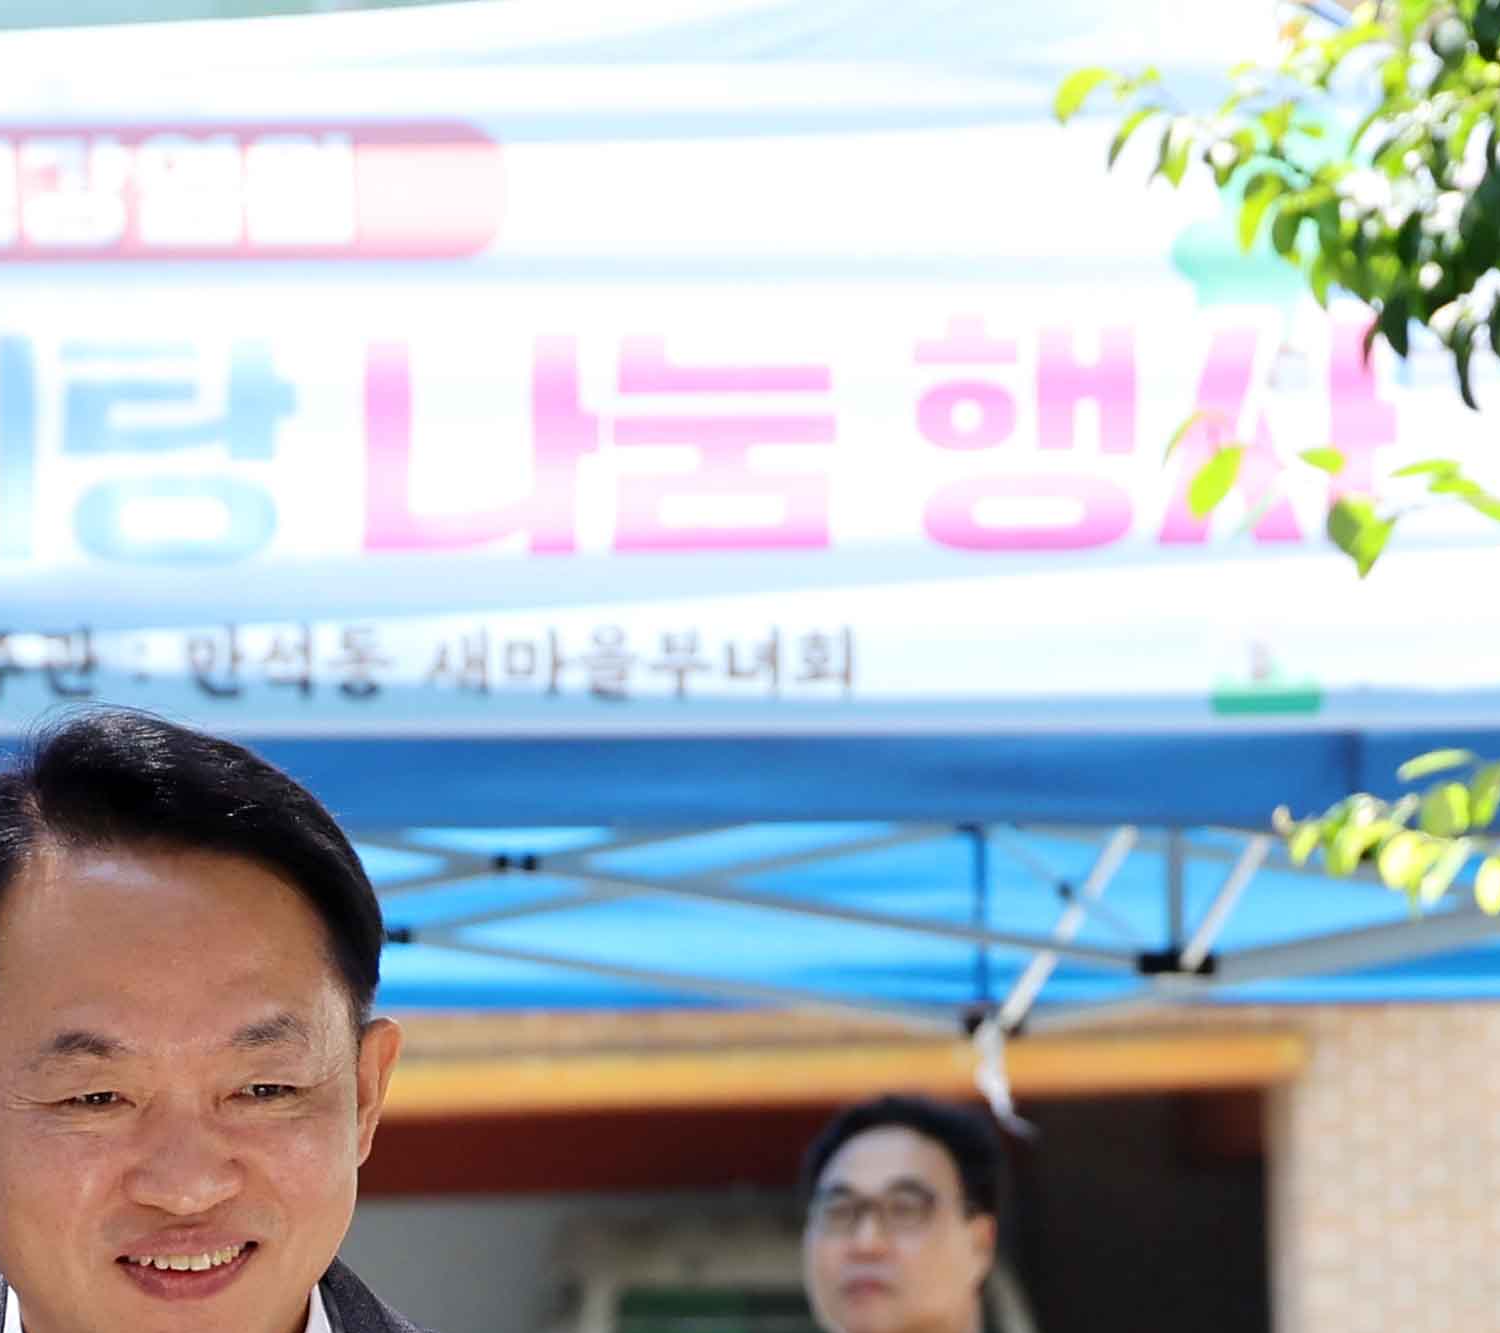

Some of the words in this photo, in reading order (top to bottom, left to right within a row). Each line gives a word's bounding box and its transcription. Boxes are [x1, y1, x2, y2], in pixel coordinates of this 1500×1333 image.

[360, 330, 840, 556] 나눔
[908, 312, 1400, 556] 행사
[183, 622, 394, 702] 만석동
[428, 624, 858, 702] 새마을부녀회
